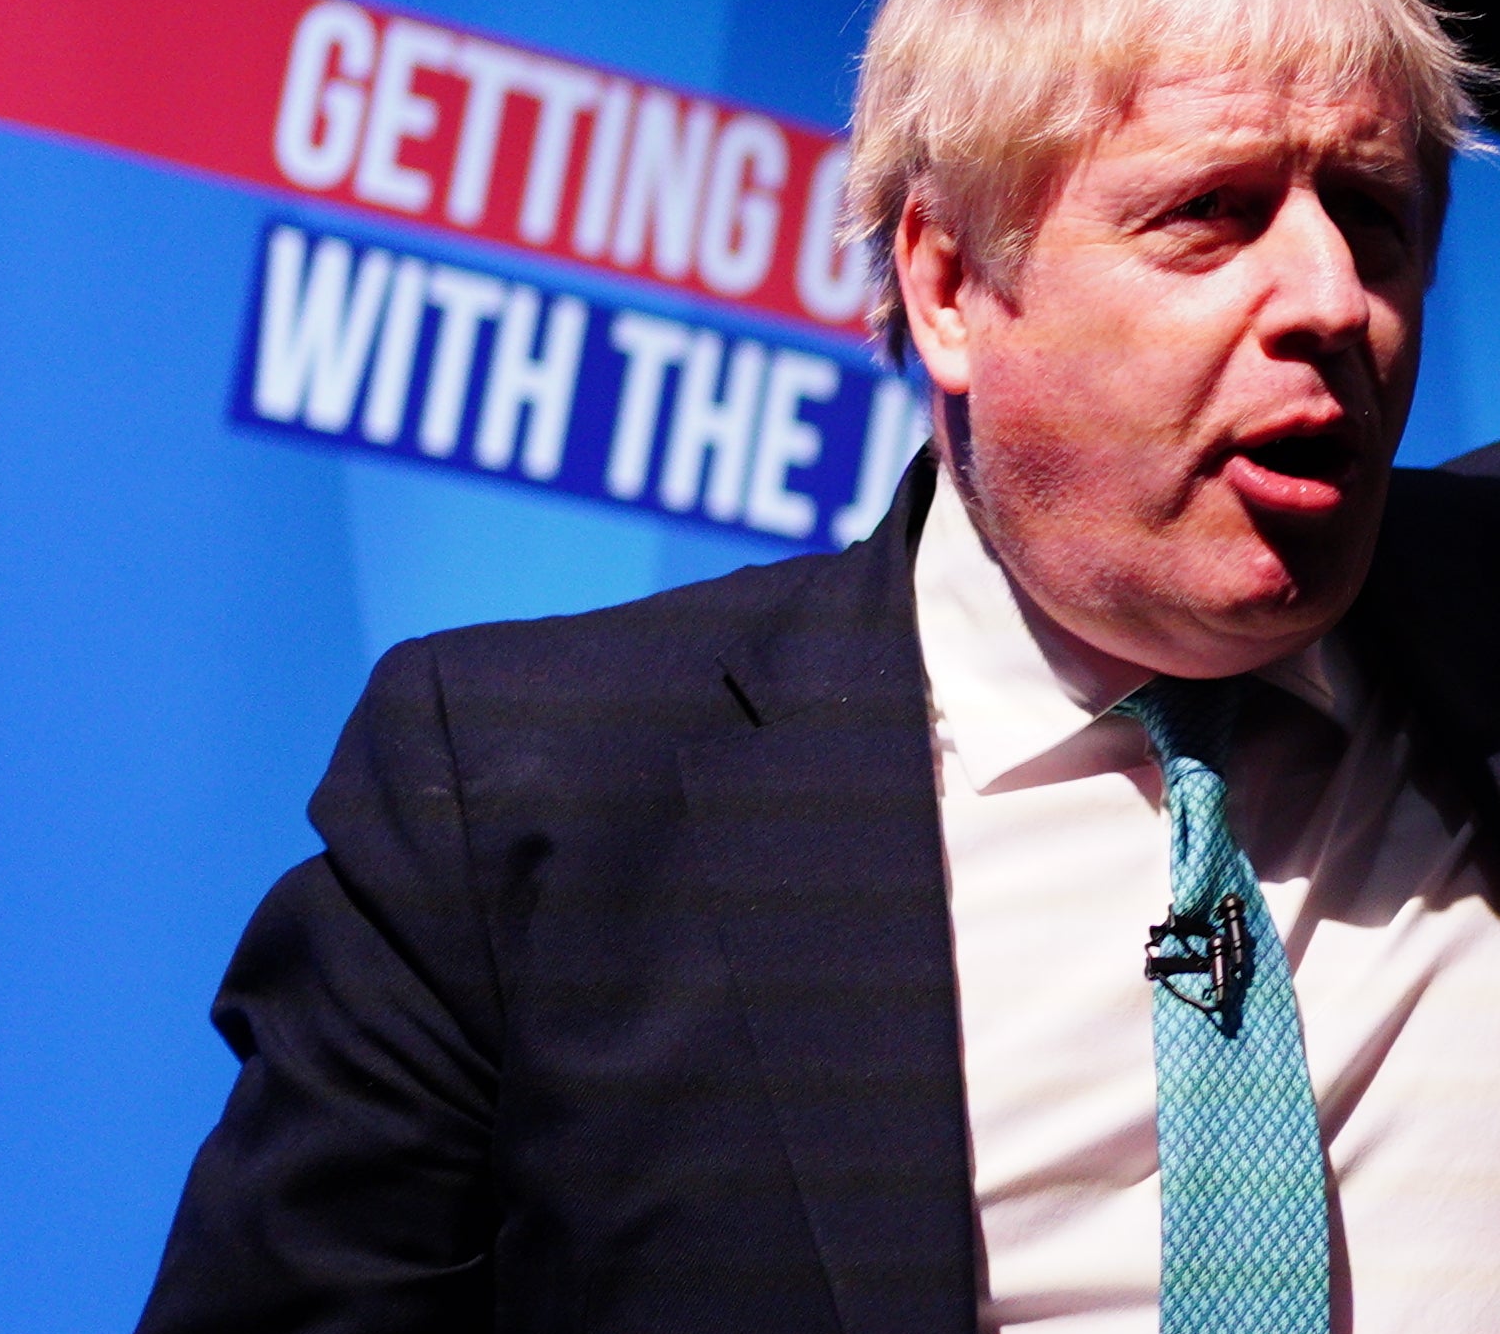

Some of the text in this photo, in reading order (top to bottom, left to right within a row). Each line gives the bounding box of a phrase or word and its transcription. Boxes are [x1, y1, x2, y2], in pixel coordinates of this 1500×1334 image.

[274, 0, 874, 324] GETTING O
[252, 225, 589, 481] WITH
[606, 307, 842, 540] THE
